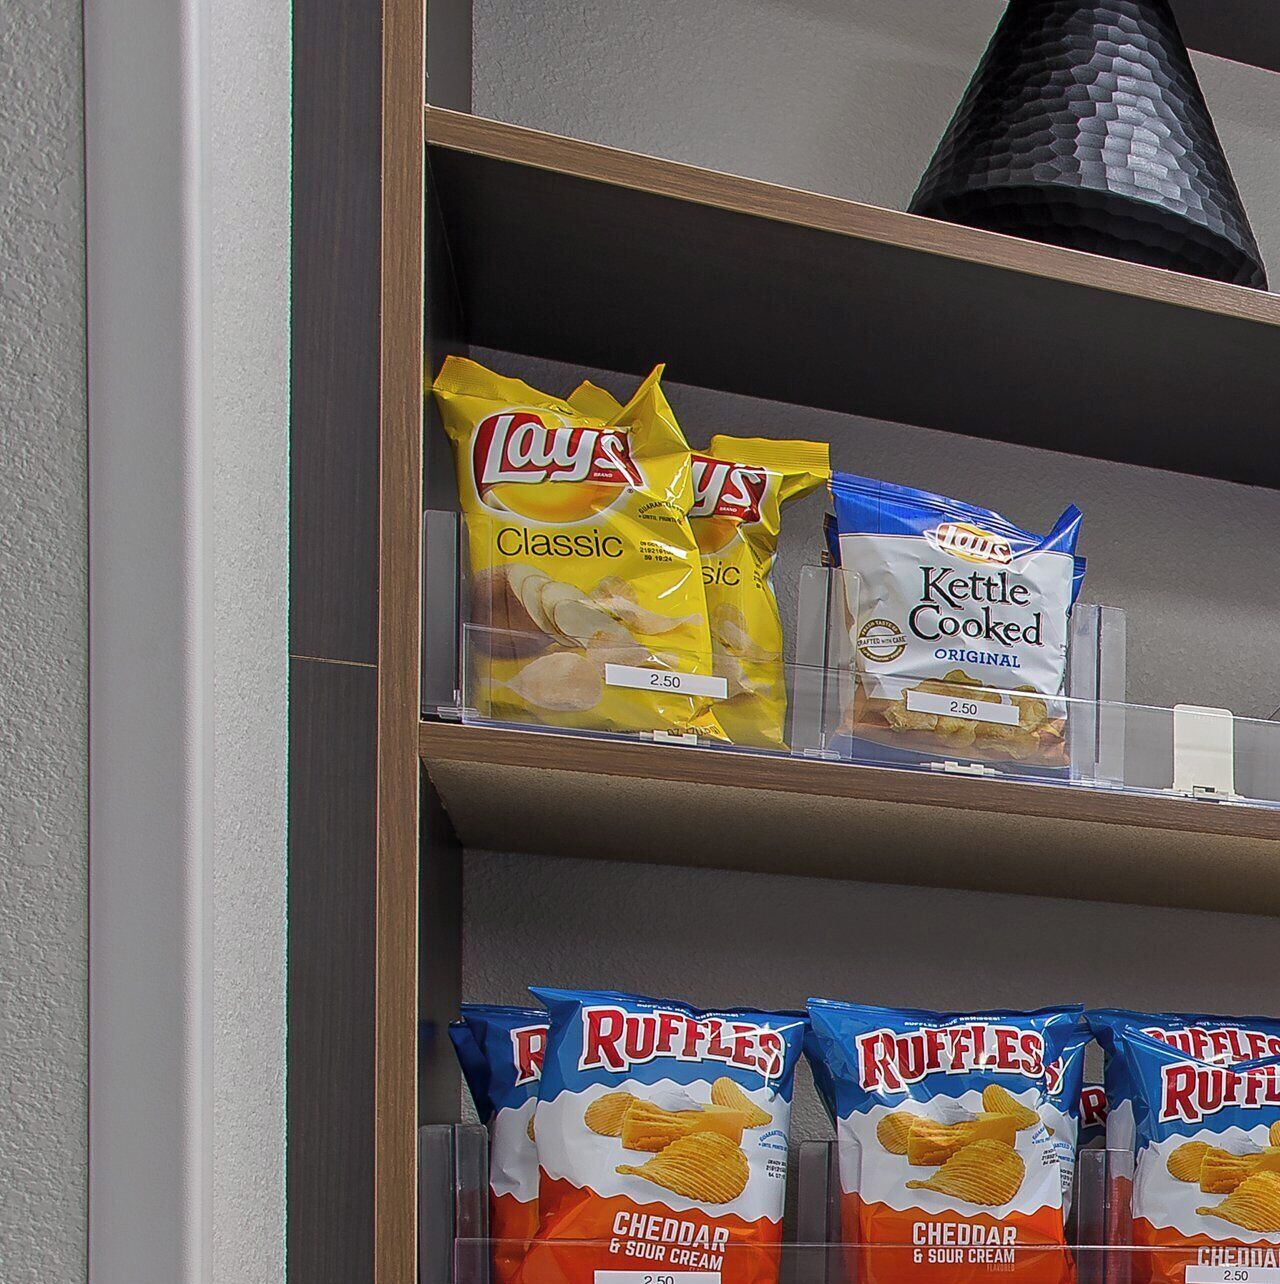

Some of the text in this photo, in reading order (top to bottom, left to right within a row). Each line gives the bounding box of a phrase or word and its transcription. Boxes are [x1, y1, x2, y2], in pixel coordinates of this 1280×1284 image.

[496, 528, 624, 559] Classic
[919, 566, 1030, 607] Kettle
[909, 604, 1044, 648] Cooked
[934, 647, 1021, 669] ORIGINAL
[650, 673, 682, 689] 2.50
[950, 701, 978, 716] 2.50
[580, 1006, 785, 1080] RUFFLES
[858, 1027, 1045, 1091] RUFFLES
[612, 1211, 730, 1253] CHEDDAR
[912, 1222, 1017, 1246] CHEDDAR
[609, 1237, 724, 1272] & SOUR CREAM
[913, 1249, 1016, 1264] & SOUR CREAM
[1223, 1270, 1249, 1281] 2.50
